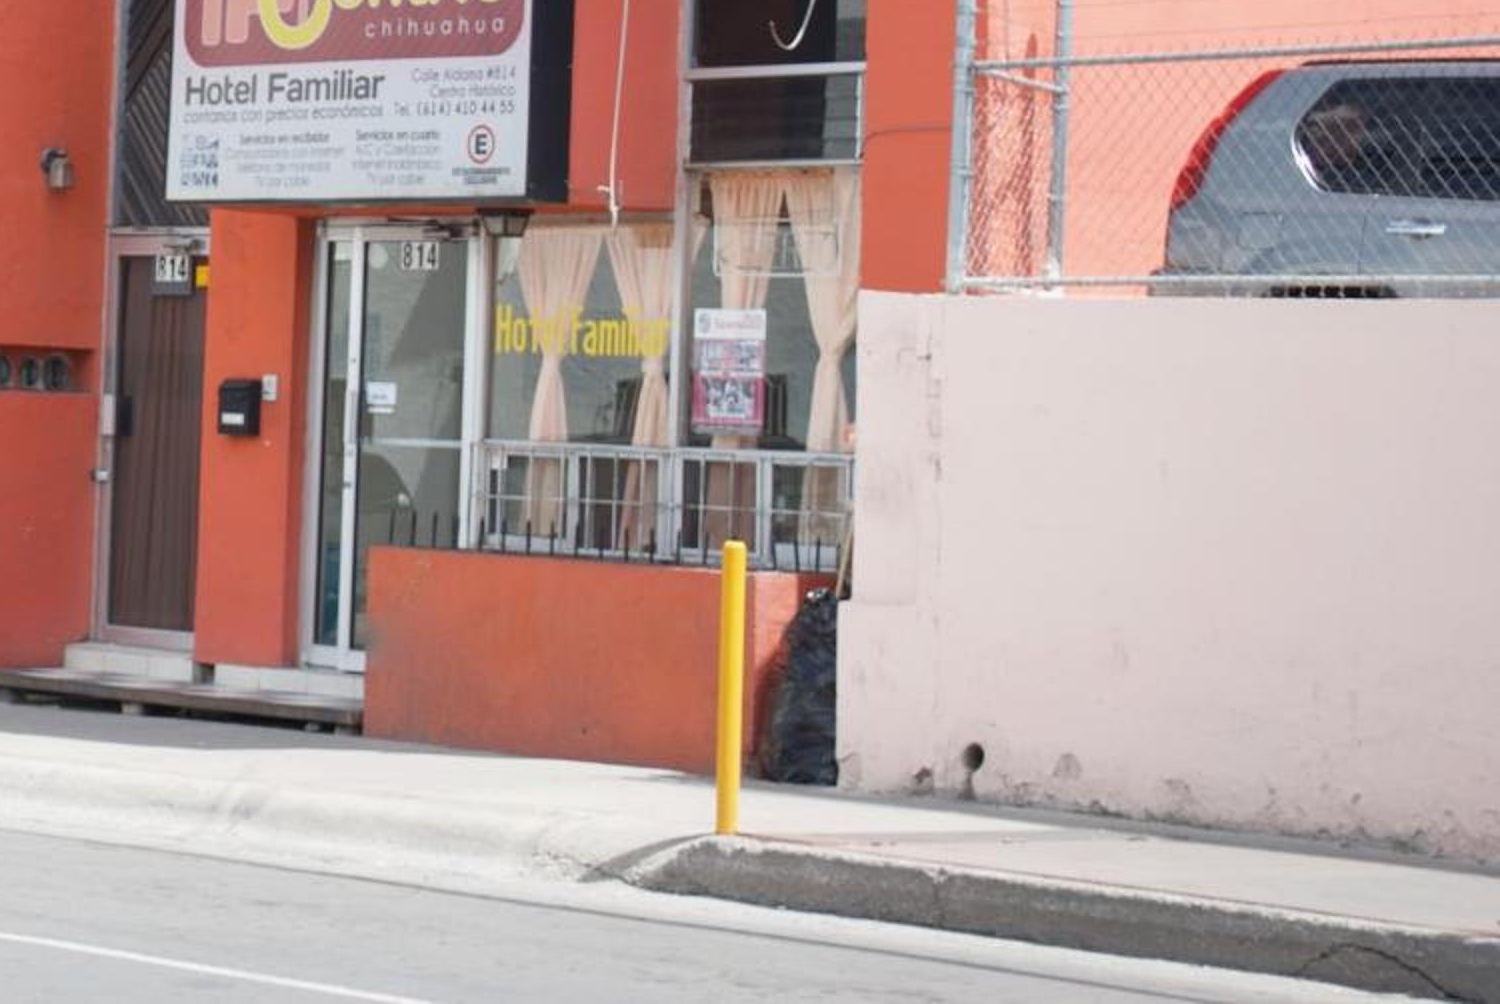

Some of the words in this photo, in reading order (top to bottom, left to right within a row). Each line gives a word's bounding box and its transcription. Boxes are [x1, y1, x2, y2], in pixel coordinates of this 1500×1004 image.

[364, 16, 504, 38] chihuahua
[185, 73, 258, 106] Hotel
[268, 69, 385, 103] Familiar
[481, 99, 496, 114] 44
[474, 133, 487, 155] E
[403, 242, 437, 268] 814
